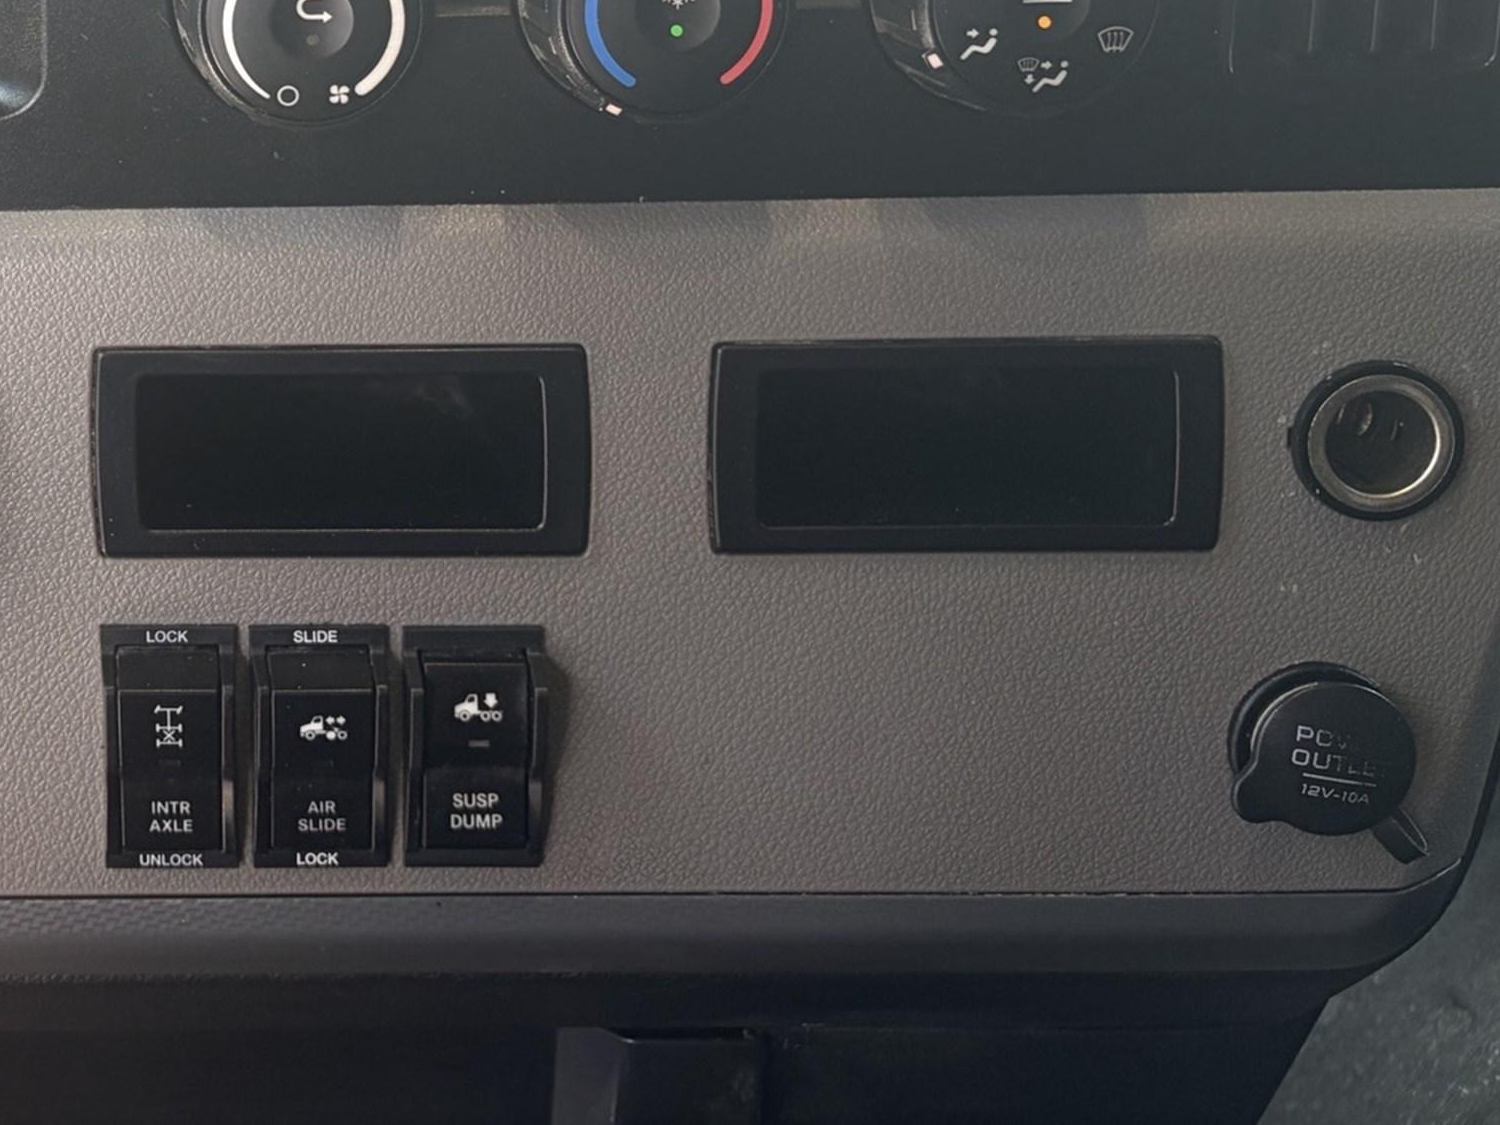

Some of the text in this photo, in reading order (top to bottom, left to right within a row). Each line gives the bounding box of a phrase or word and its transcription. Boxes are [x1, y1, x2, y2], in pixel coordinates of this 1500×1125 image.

[145, 629, 189, 644] LOCK
[292, 629, 338, 644] SLIDE
[452, 792, 500, 809] SUSP
[1301, 783, 1370, 804] 12V-10A
[150, 800, 191, 816] INTR
[307, 800, 336, 815] AIR
[149, 818, 194, 834] AXLE
[297, 817, 347, 832] SLIDE
[450, 813, 503, 829] DUMP
[139, 853, 203, 867] UNLOCK
[296, 852, 339, 866] LOCK
